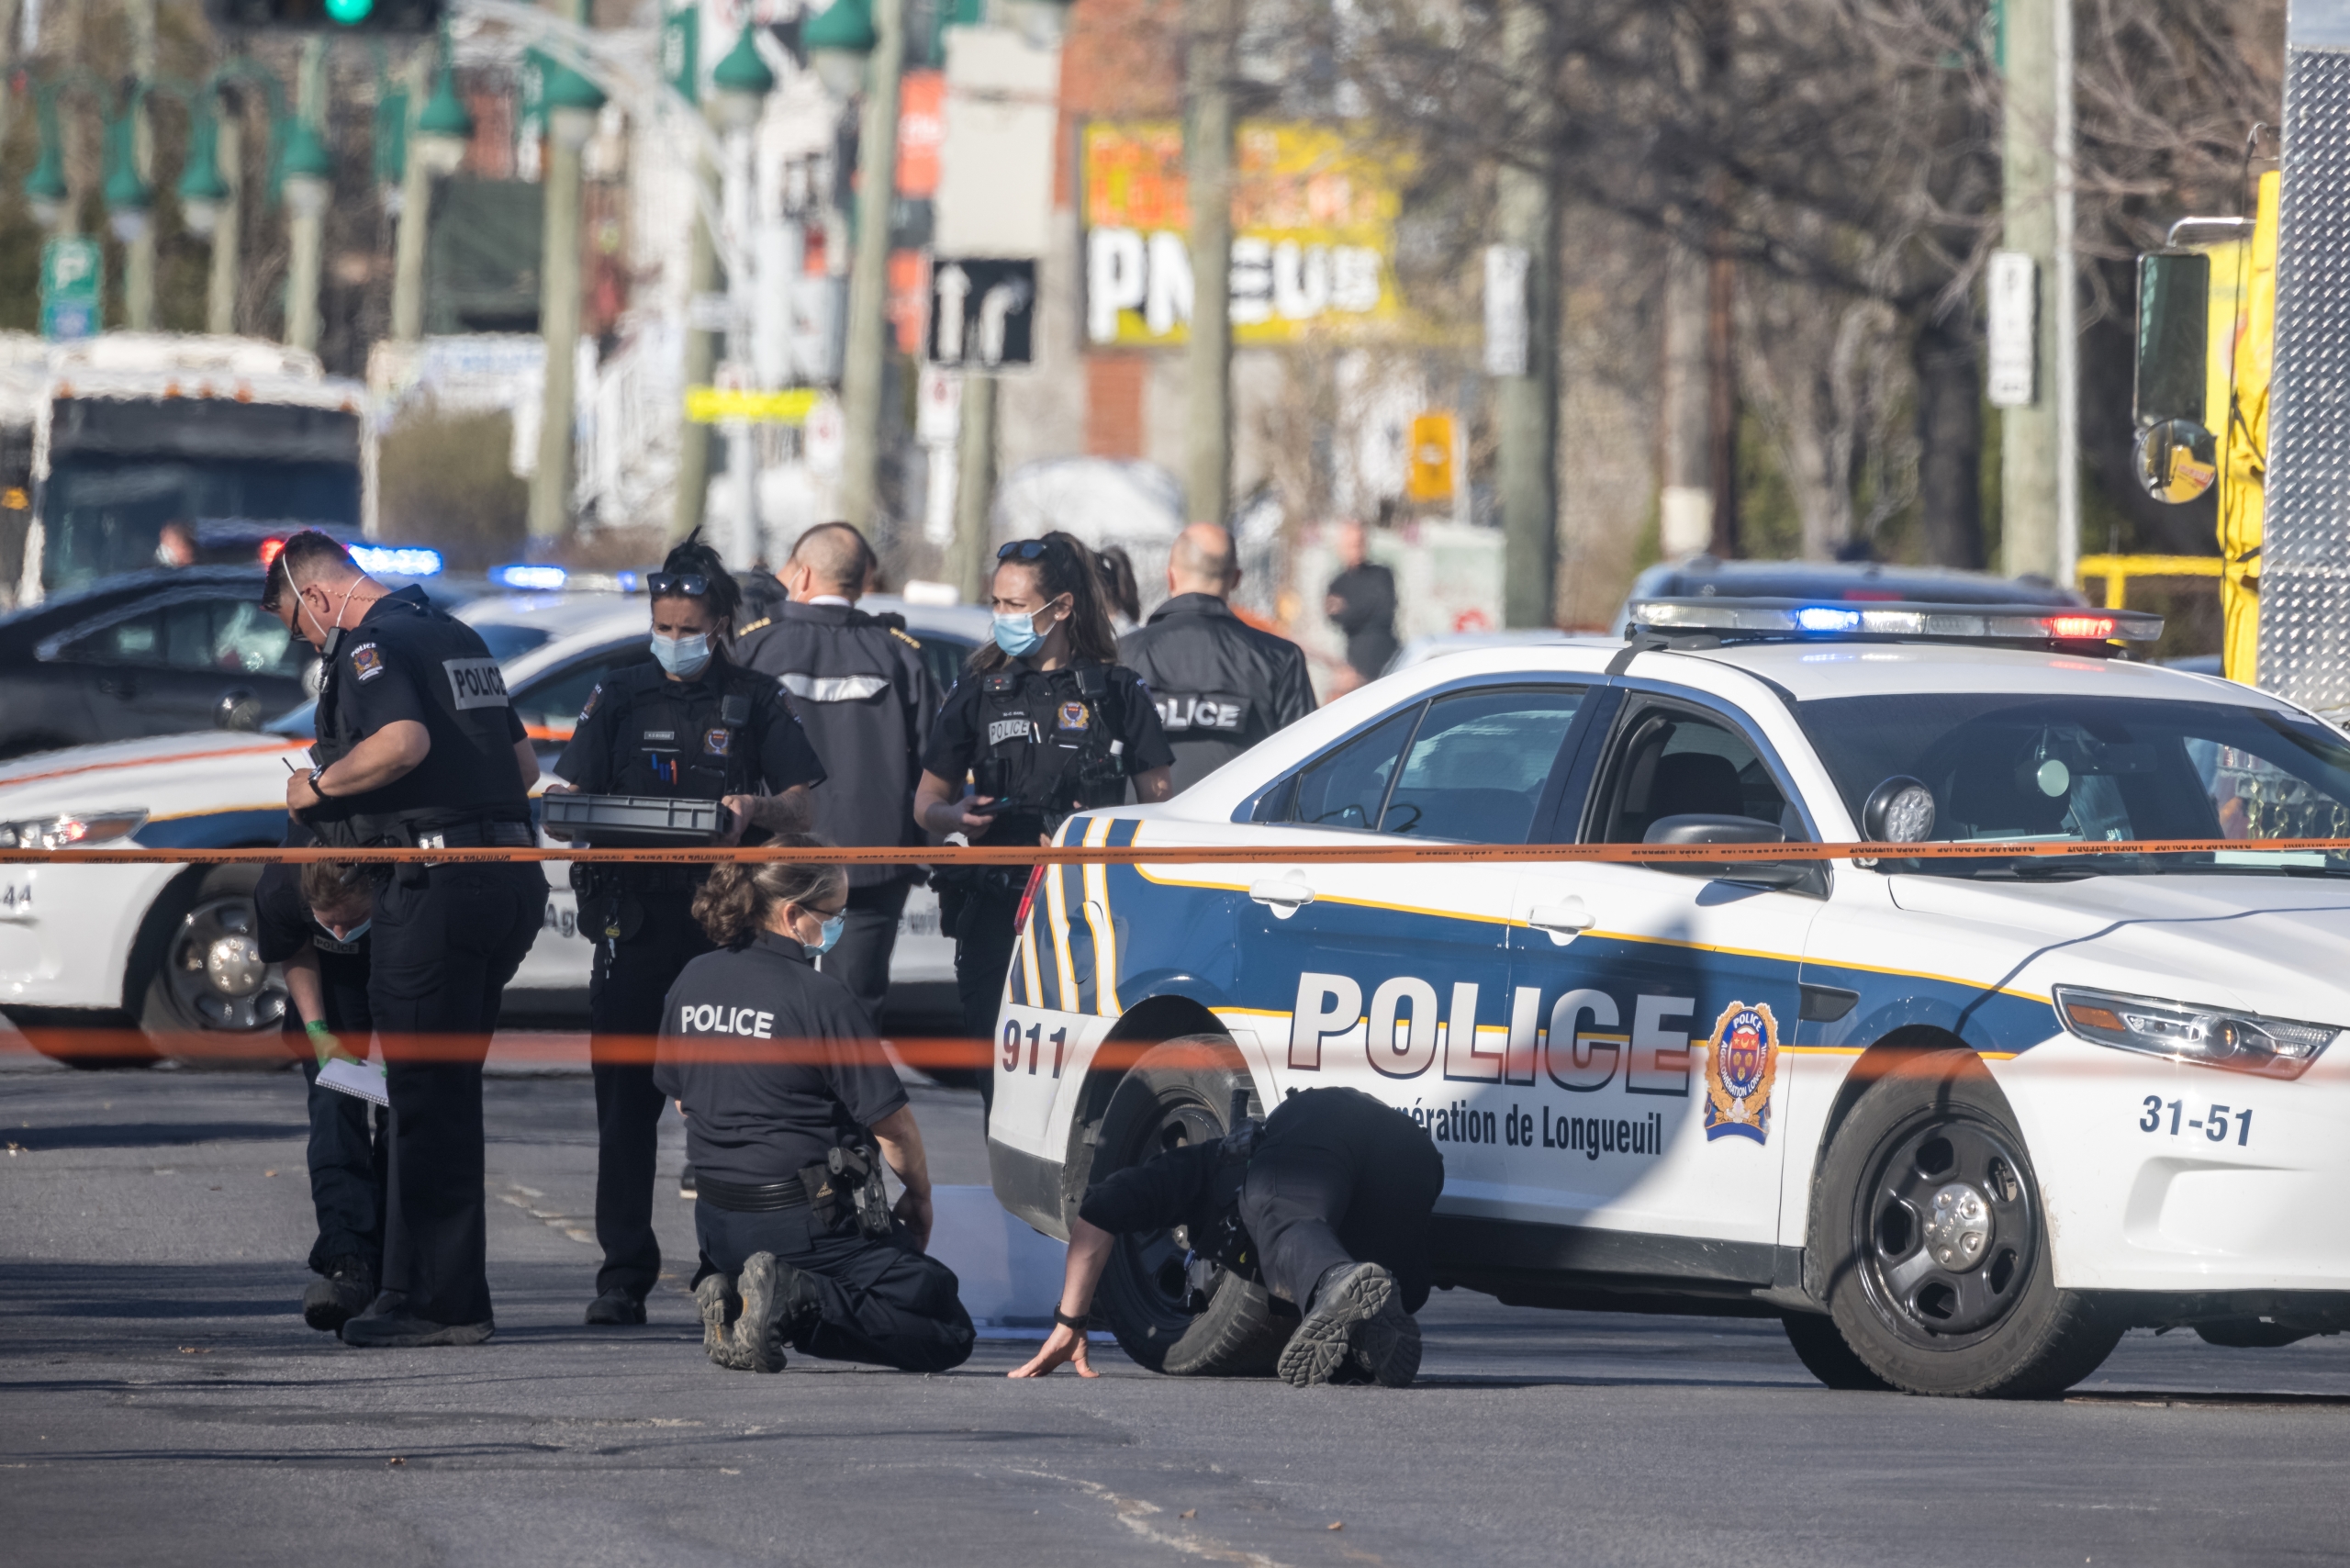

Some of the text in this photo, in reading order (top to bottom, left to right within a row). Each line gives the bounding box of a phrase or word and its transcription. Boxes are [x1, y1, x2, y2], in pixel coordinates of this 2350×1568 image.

[453, 666, 507, 698] POLICE
[991, 721, 1027, 742] POLICE
[317, 938, 356, 953] POLICE
[681, 1004, 775, 1039] POLICE
[1288, 971, 1695, 1097] POLICE
[1733, 1013, 1762, 1032] POLICE
[1002, 1019, 1067, 1079] 911
[1748, 1042, 1767, 1092] LONGUEUIL
[1505, 1103, 1534, 1147] de
[1543, 1105, 1662, 1160] Longueuil
[2140, 1095, 2253, 1147] 31-51
